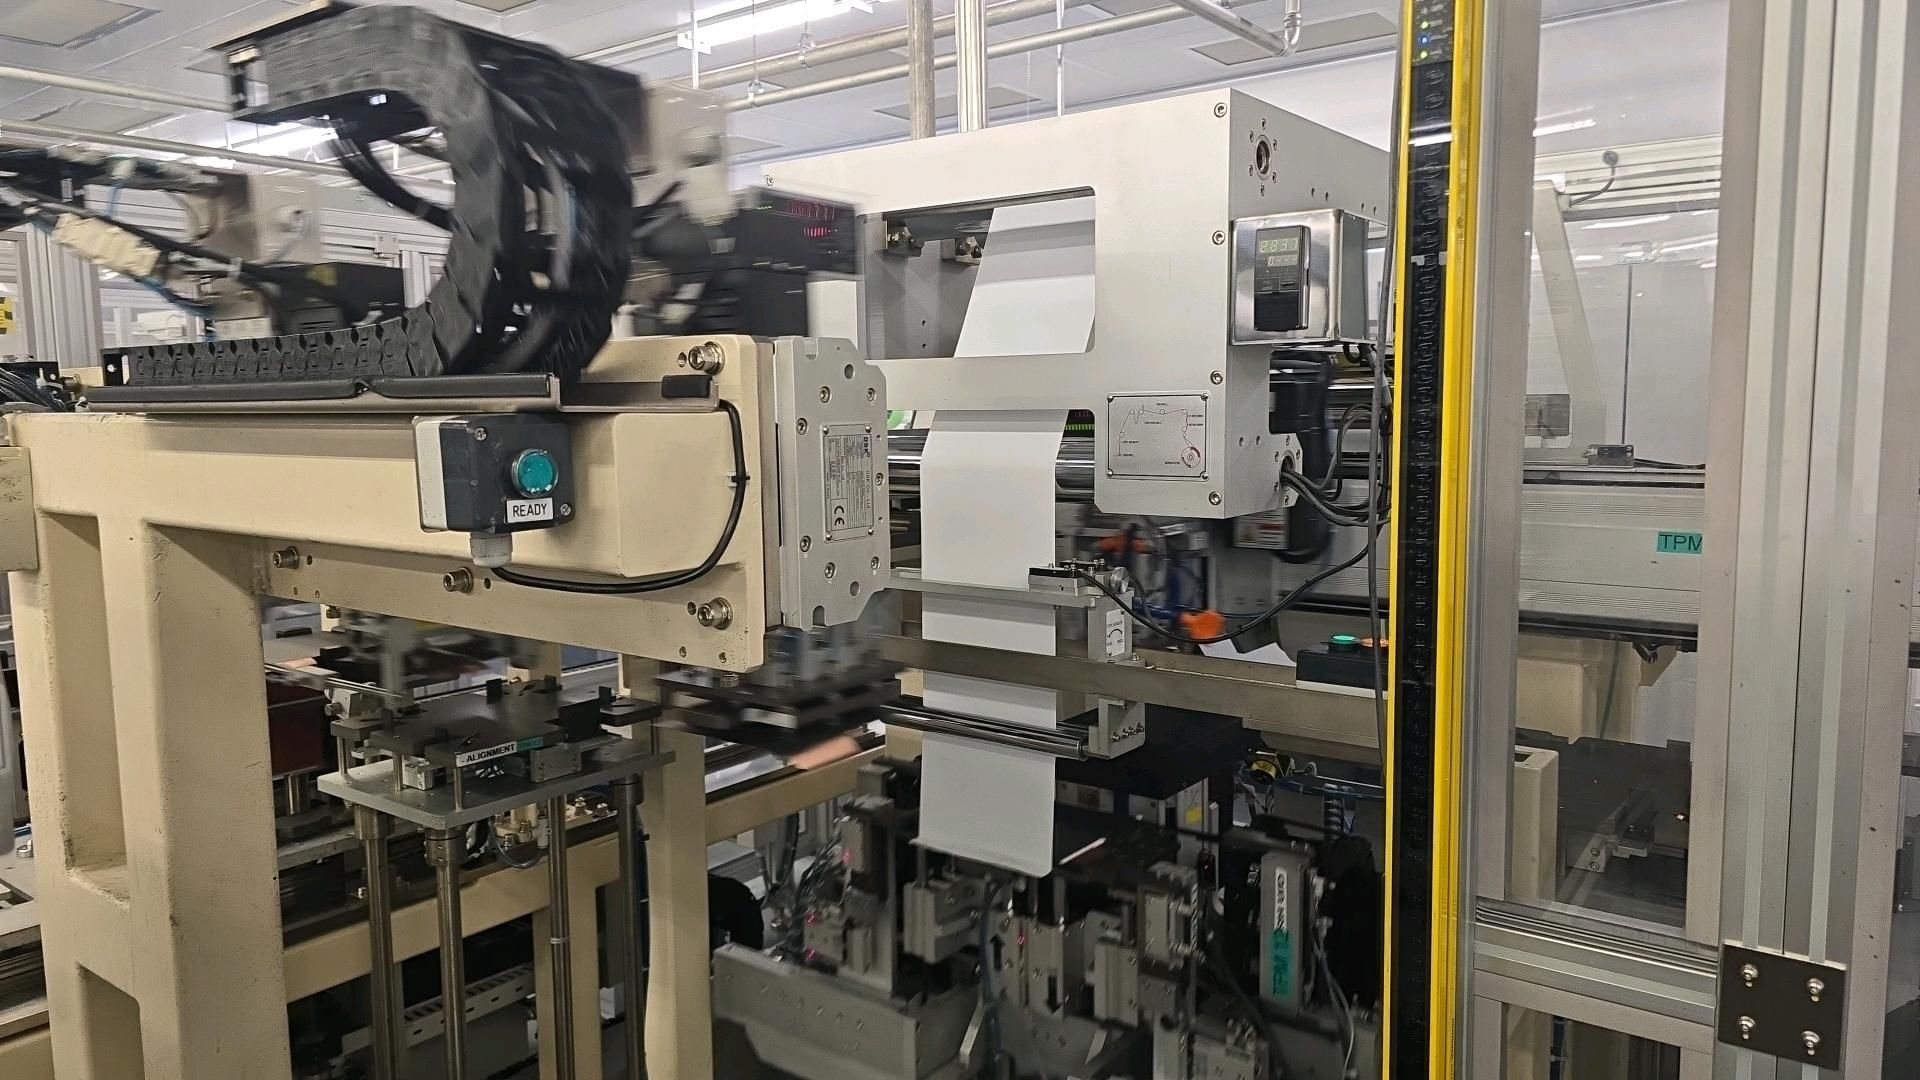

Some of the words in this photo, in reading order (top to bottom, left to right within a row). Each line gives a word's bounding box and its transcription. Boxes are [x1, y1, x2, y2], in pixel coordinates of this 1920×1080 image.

[512, 503, 547, 517] READY
[1659, 534, 1703, 551] TPM
[466, 743, 515, 762] ALIGNMENT
